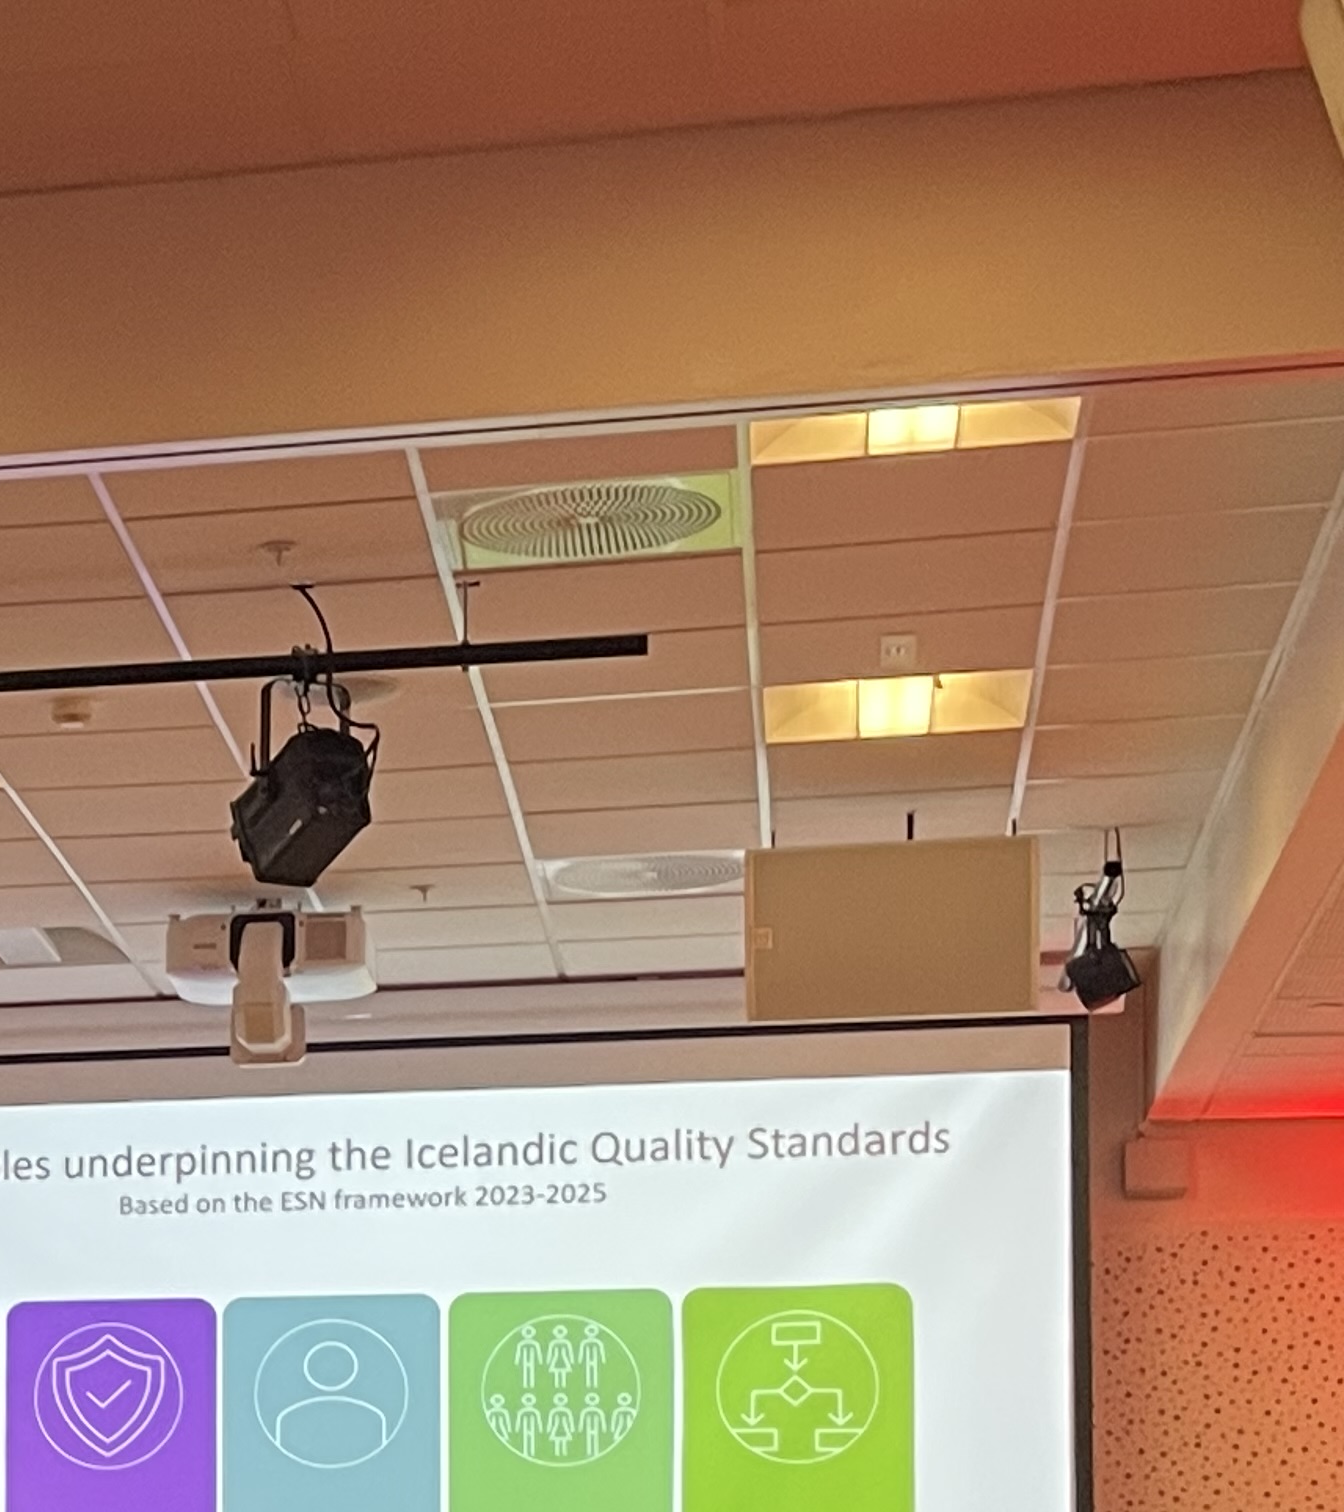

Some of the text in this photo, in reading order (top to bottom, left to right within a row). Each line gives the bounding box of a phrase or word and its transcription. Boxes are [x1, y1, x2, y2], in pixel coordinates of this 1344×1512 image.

[64, 1141, 317, 1185] underpinning
[327, 1137, 392, 1173] the
[406, 1131, 578, 1170] Icelandic
[590, 1127, 735, 1170] Quality
[747, 1119, 951, 1160] Standards
[119, 1181, 608, 1216] Based on the ESN framework 2023-2025
